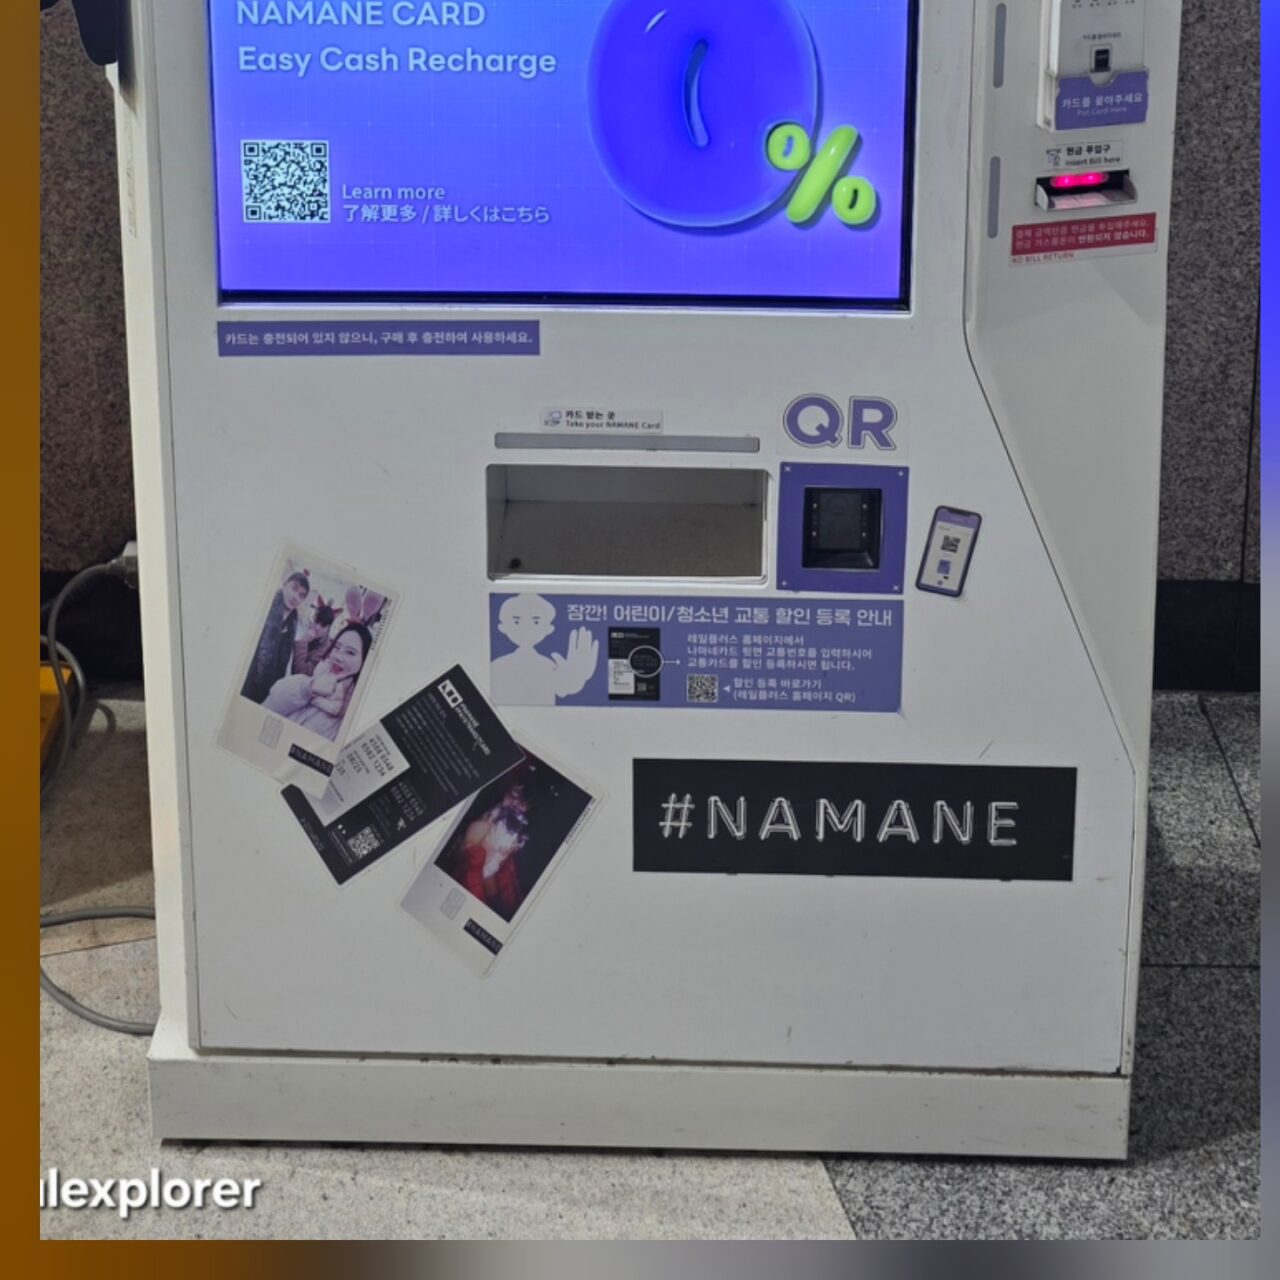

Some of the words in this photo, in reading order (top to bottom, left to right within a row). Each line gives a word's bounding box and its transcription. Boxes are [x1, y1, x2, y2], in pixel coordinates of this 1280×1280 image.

[236, 1, 384, 25] NAMANE
[391, 1, 486, 26] CARD
[238, 46, 312, 77] Easy
[319, 46, 399, 71] Cash
[407, 47, 557, 79] Recharge
[342, 183, 394, 201] Learn
[397, 186, 446, 201] more
[342, 204, 418, 222] 了解更多
[434, 204, 551, 223] 詳しくはこちら
[225, 332, 259, 345] 카드는
[263, 332, 309, 344] 충전되어
[312, 332, 335, 344] 있지
[380, 332, 403, 344] 구매
[407, 332, 418, 344] 후
[422, 332, 468, 344] 충전하여
[471, 332, 534, 345] 사용하세요.
[783, 393, 898, 451] QR
[566, 604, 608, 621] 잠깐!
[613, 604, 729, 624] 어린이/청소년
[734, 607, 770, 624] 교통
[775, 608, 811, 625] 할인
[815, 609, 851, 626] 등록
[857, 609, 892, 627] 안내
[659, 793, 1020, 847] #NAMANE
